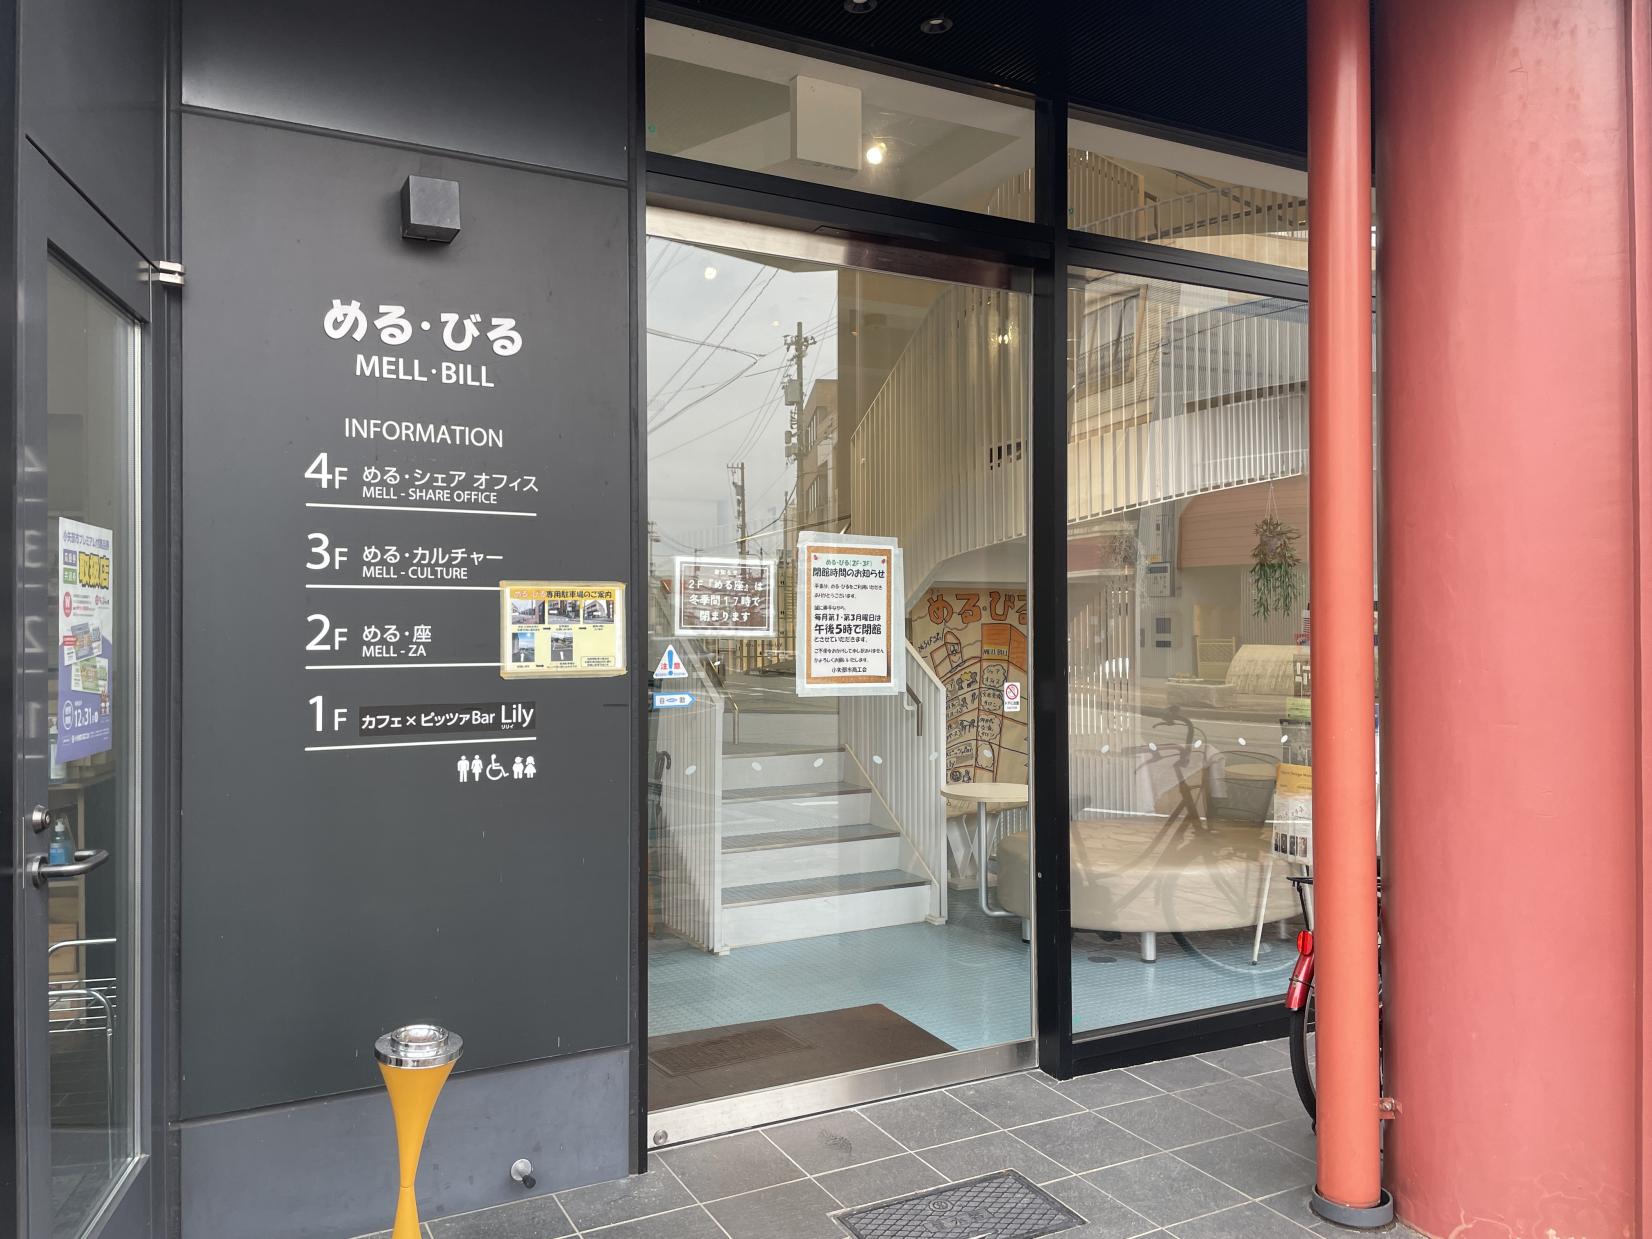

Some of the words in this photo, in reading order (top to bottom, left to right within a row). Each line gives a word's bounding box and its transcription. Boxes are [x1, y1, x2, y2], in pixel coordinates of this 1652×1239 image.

[323, 299, 523, 357] める・びる
[344, 417, 504, 448] INFORMATION
[304, 452, 348, 489] 4F
[362, 466, 466, 488] める・シェア
[473, 473, 539, 493] オフィス
[362, 486, 397, 500] MELL
[408, 488, 451, 502] SHARE
[453, 490, 498, 504] OFFICE
[305, 532, 348, 570] 3F
[362, 545, 504, 566] める・カルチャー
[362, 566, 397, 578] MELL
[408, 566, 468, 580] CULTURE
[813, 568, 885, 578] 閉館時間のお知らせ
[699, 610, 751, 622] 閉まります
[305, 614, 348, 651] 2F
[362, 624, 432, 643] める・座
[814, 623, 882, 635] 午後5時で閉館
[362, 645, 397, 657] MELL
[408, 645, 427, 657] ZA
[308, 695, 348, 732] 1F
[501, 704, 534, 726] Lily
